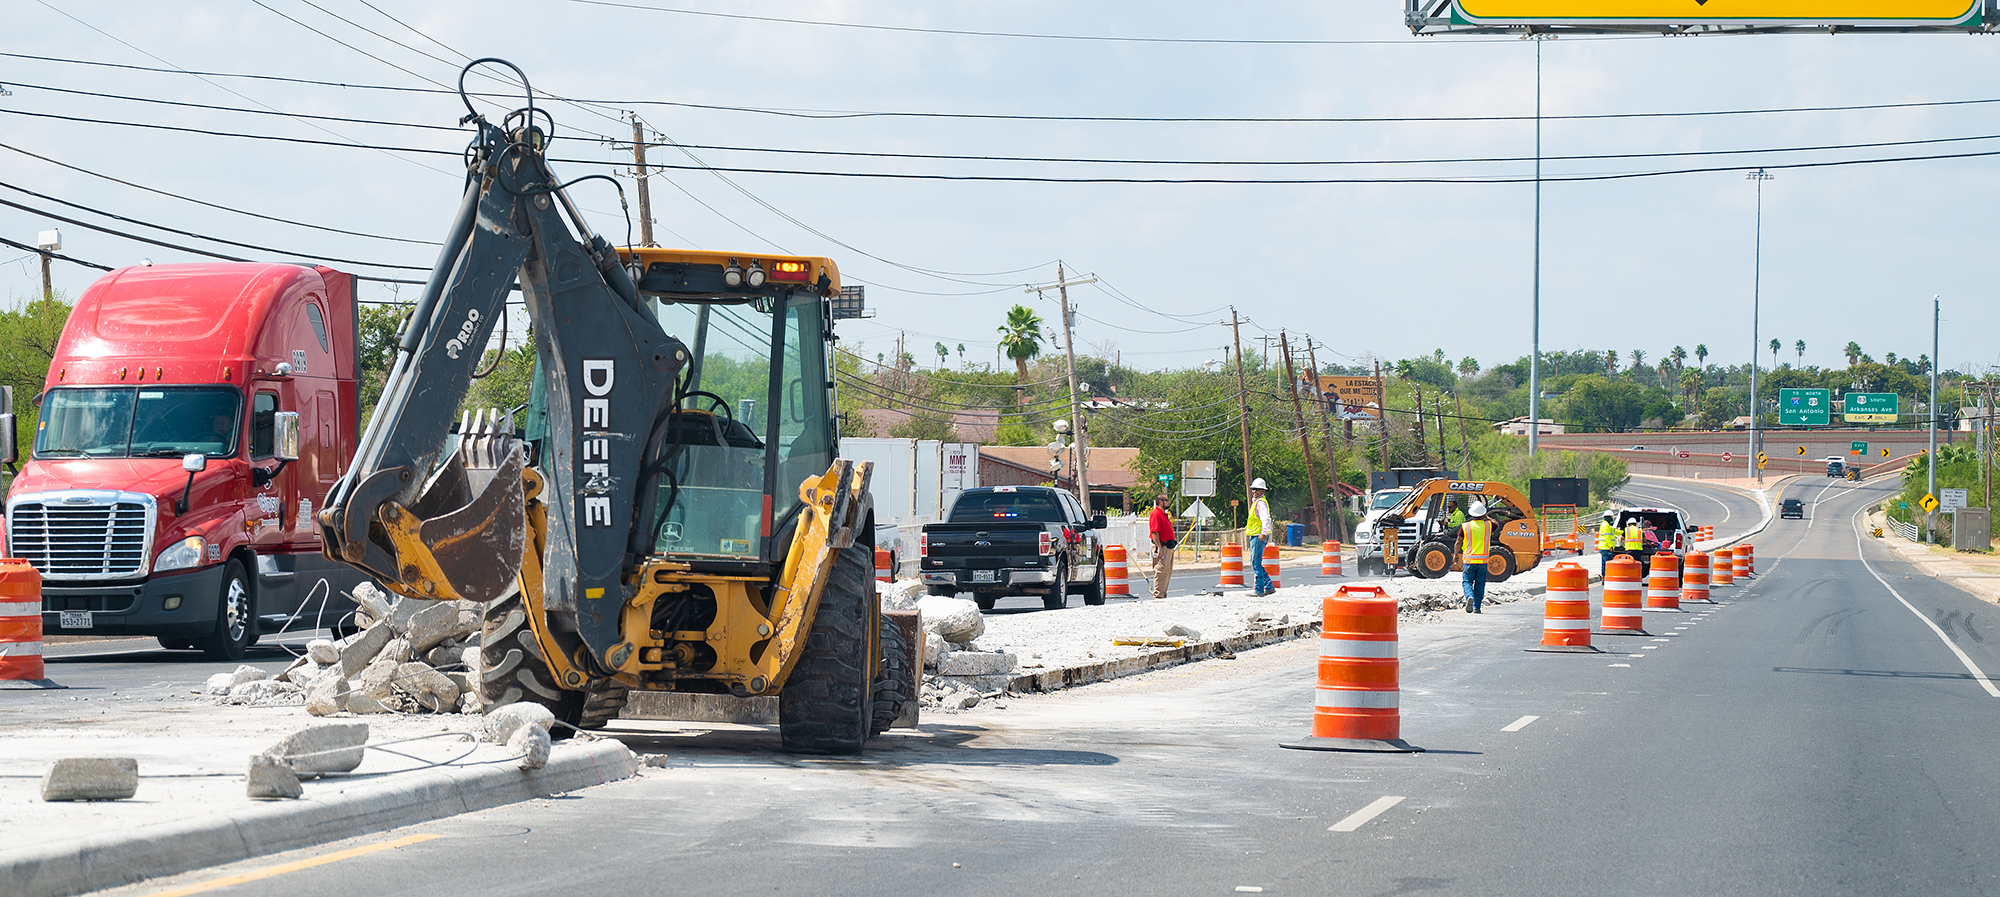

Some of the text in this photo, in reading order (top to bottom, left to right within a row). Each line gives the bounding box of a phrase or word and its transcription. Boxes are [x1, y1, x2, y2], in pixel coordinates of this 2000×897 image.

[583, 360, 614, 527] DEERE
[949, 455, 967, 465] MMT
[1449, 482, 1485, 492] CASE
